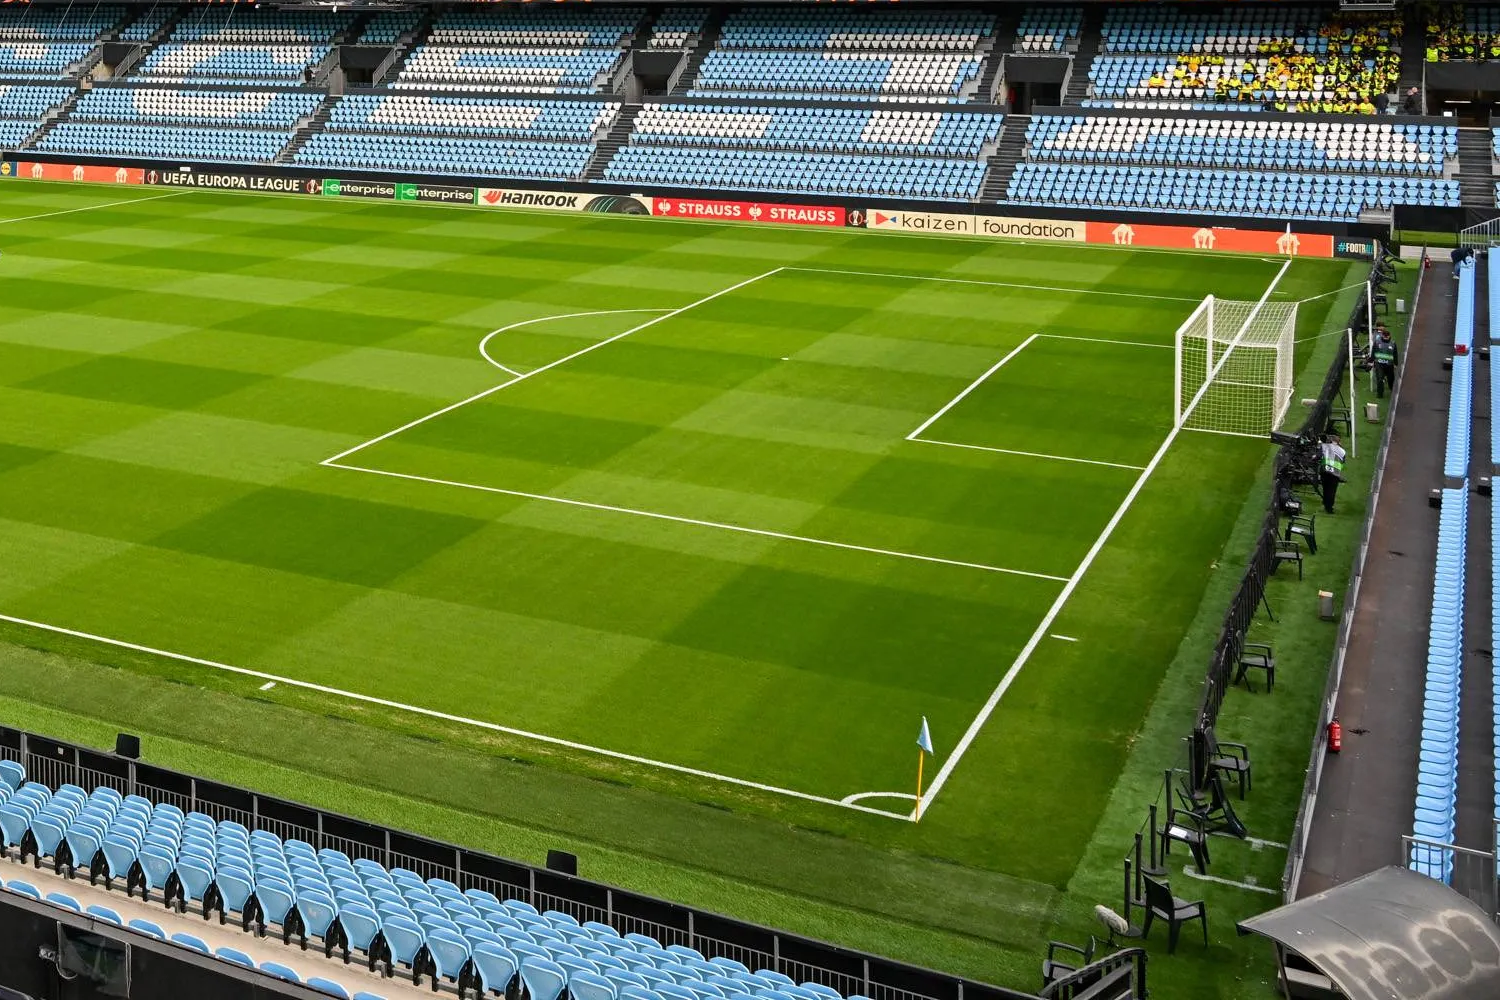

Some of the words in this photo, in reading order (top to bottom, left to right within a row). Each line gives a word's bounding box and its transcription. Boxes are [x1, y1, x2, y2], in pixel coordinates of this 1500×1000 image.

[162, 172, 194, 186] UEFA
[197, 174, 247, 189] EUROPA
[250, 177, 300, 192] LEAGUE
[329, 183, 395, 196] enterprise
[405, 187, 474, 201] enterprise
[678, 202, 741, 217] STRAUSS
[769, 207, 836, 222] STRAUSS
[902, 213, 968, 231] kaizen
[983, 219, 1075, 238] foundation
